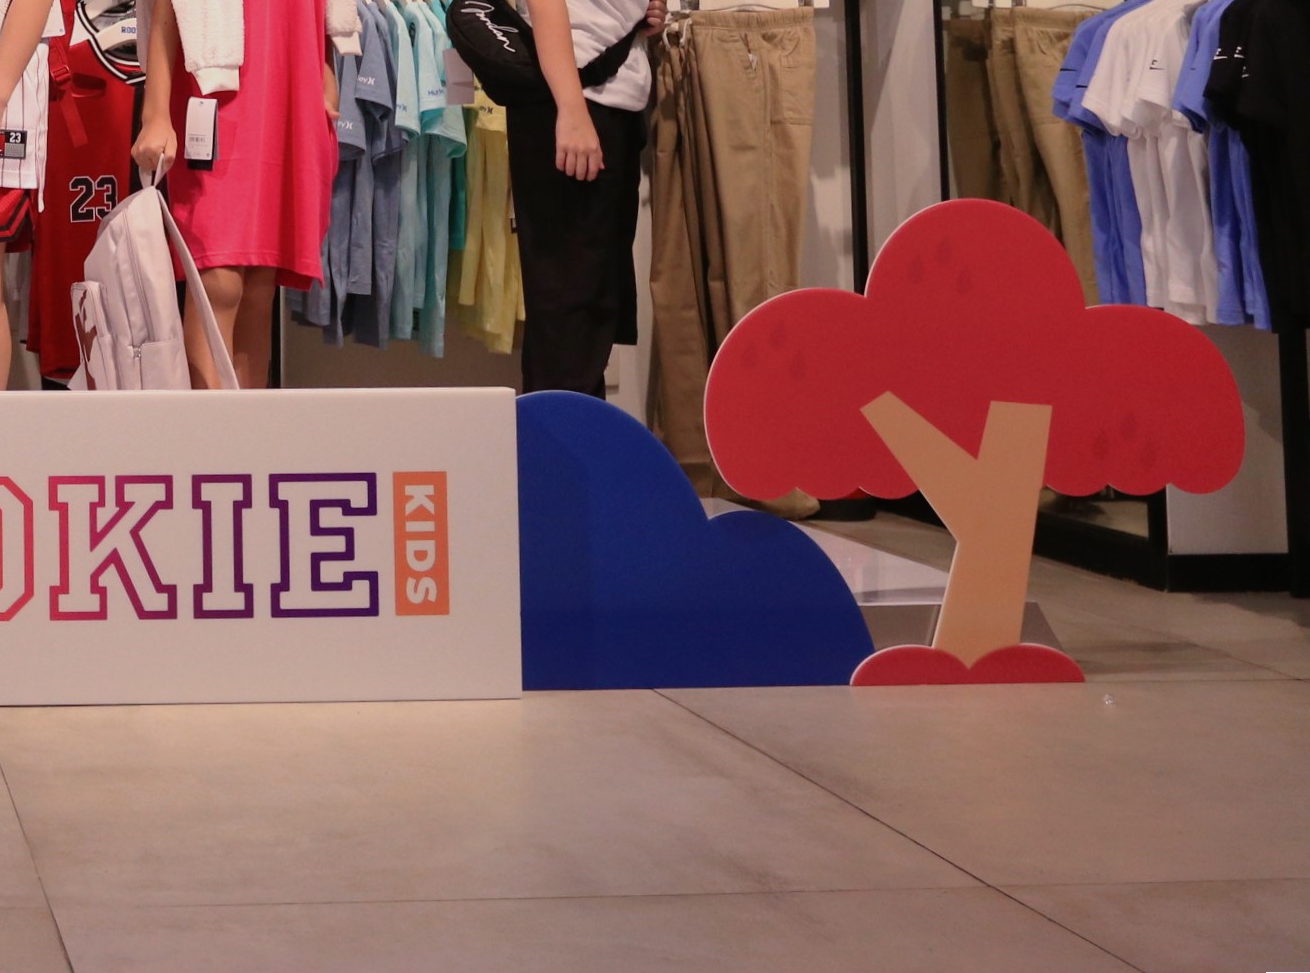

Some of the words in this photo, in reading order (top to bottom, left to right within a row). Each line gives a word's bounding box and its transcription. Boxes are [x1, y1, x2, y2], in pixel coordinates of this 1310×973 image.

[121, 26, 137, 34] ROO
[9, 132, 22, 143] 23
[69, 174, 118, 223] 23
[404, 484, 437, 605] KIDS
